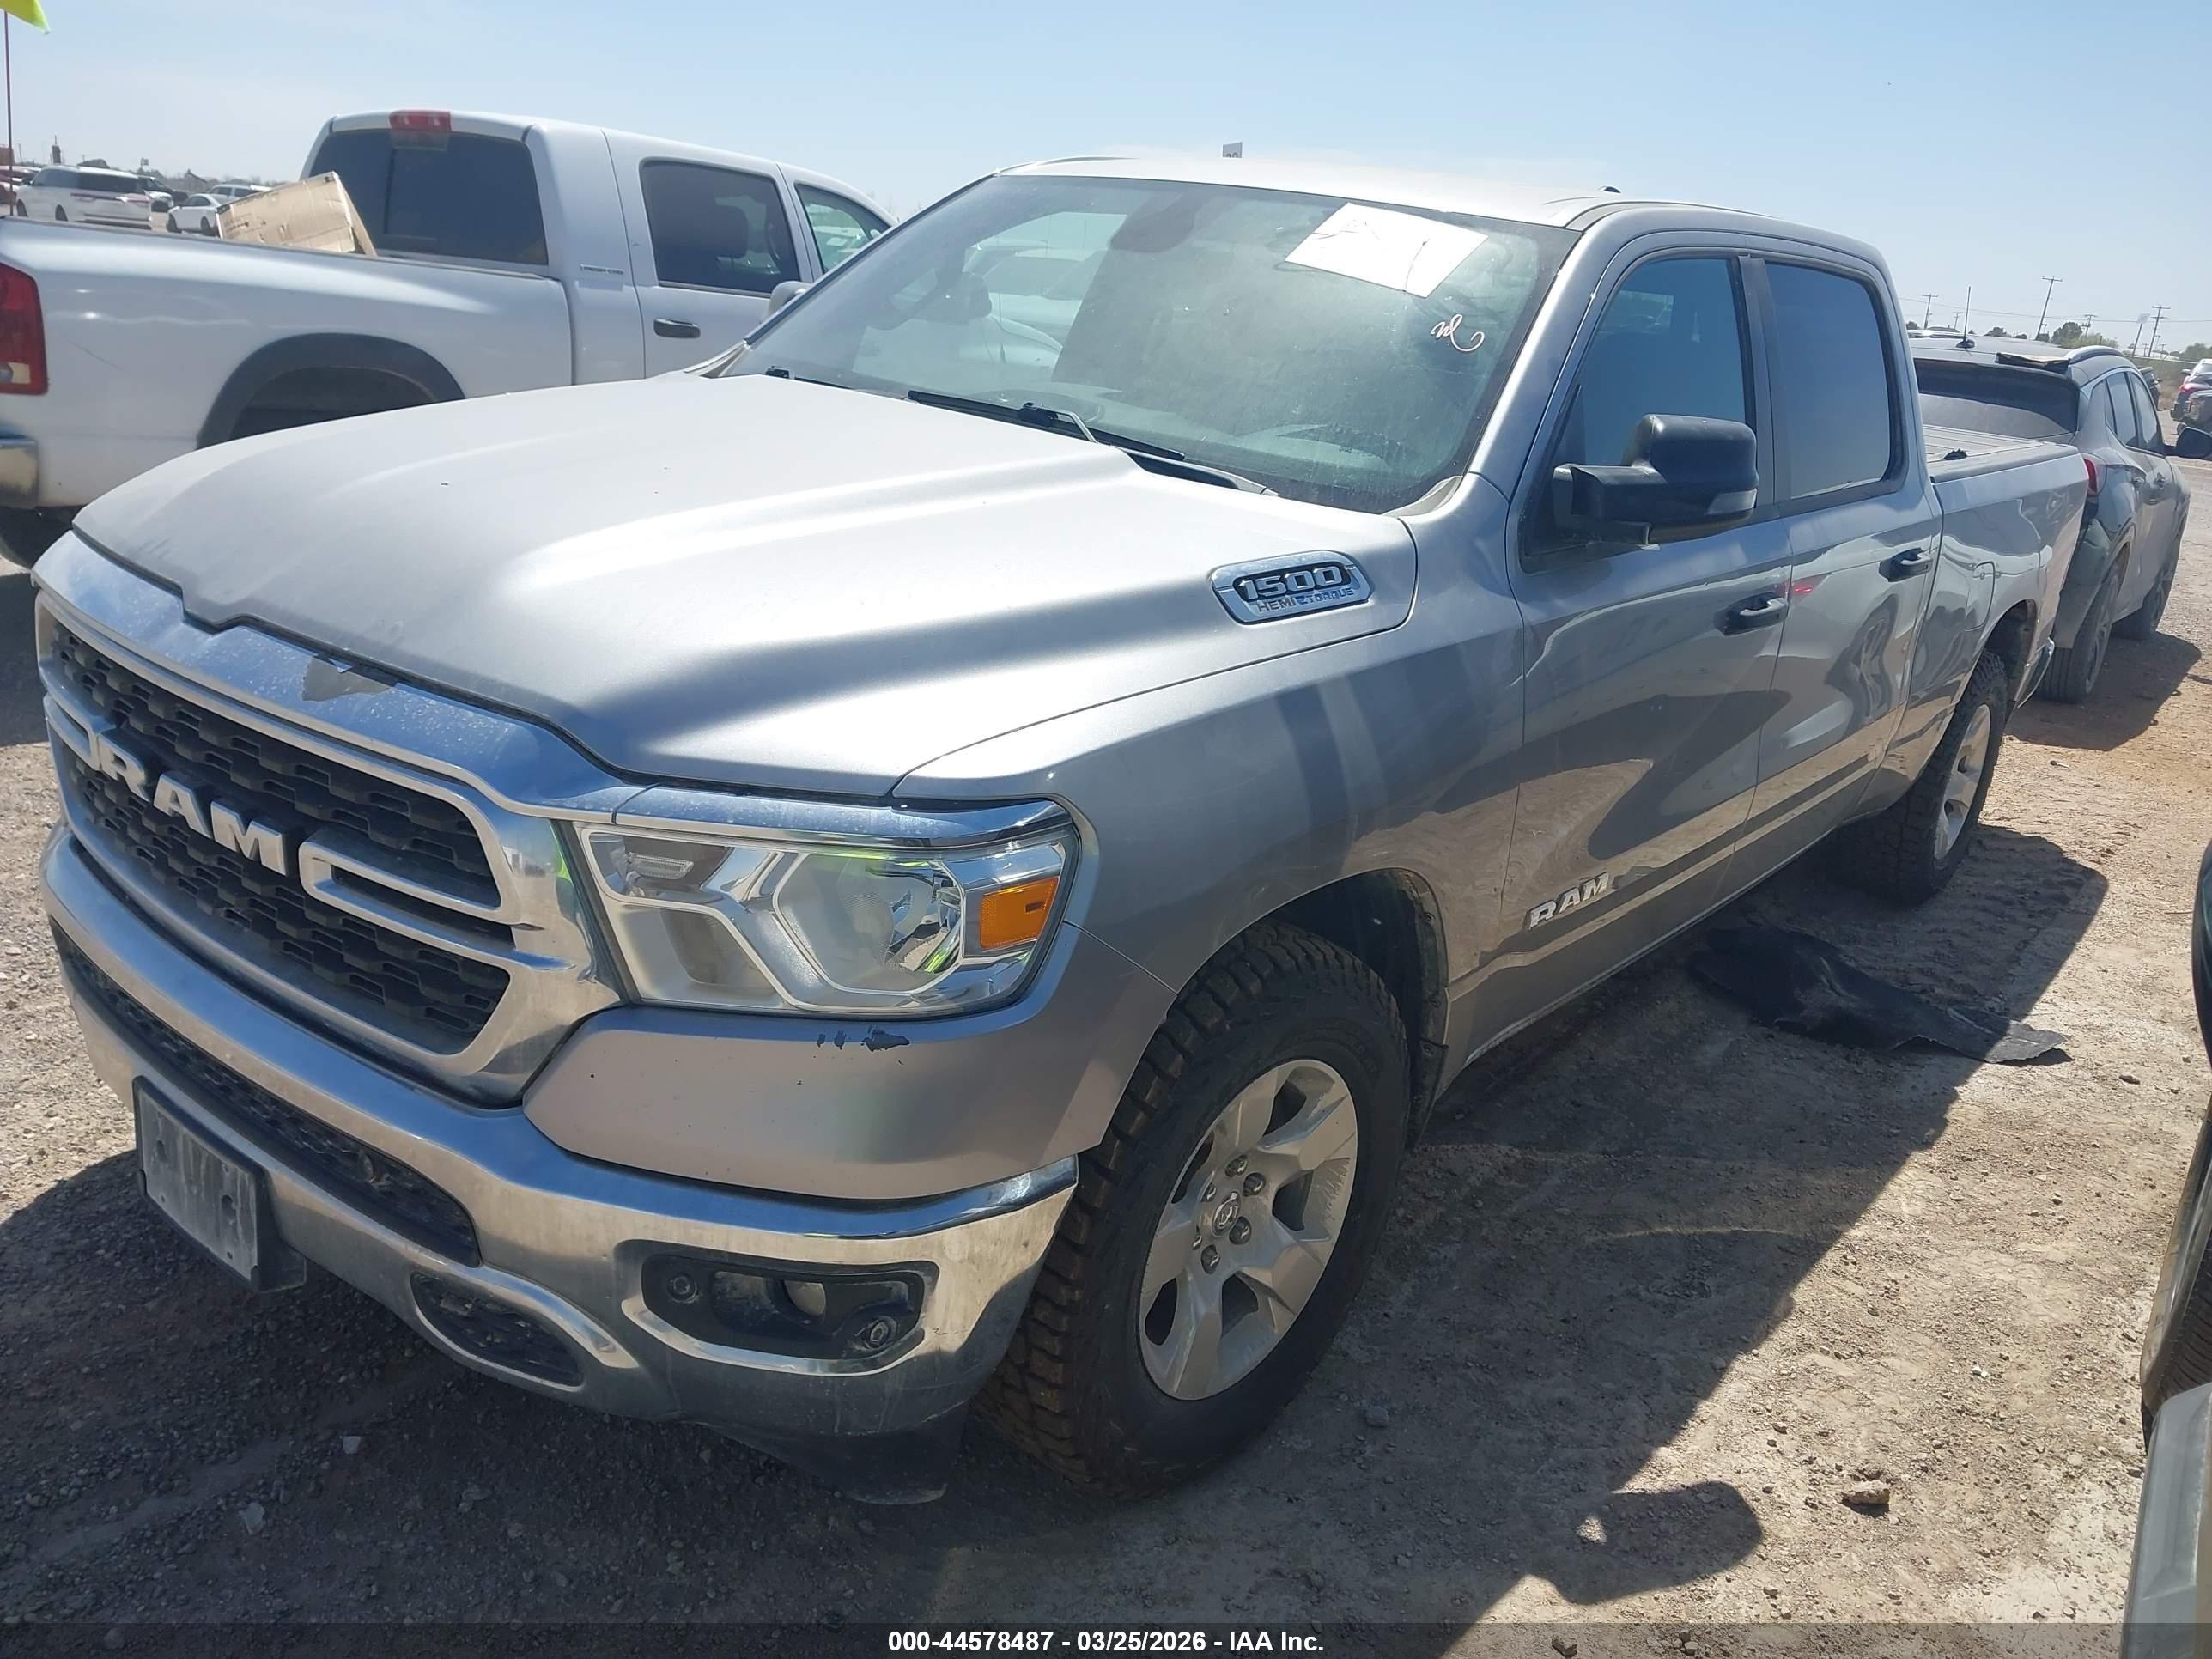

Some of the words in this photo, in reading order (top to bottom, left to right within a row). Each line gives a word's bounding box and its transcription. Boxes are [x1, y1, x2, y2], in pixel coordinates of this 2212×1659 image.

[1239, 566, 1343, 600] 1500
[1257, 596, 1296, 612] HEMI
[98, 730, 287, 876] RAM
[1527, 871, 1609, 930] RAM
